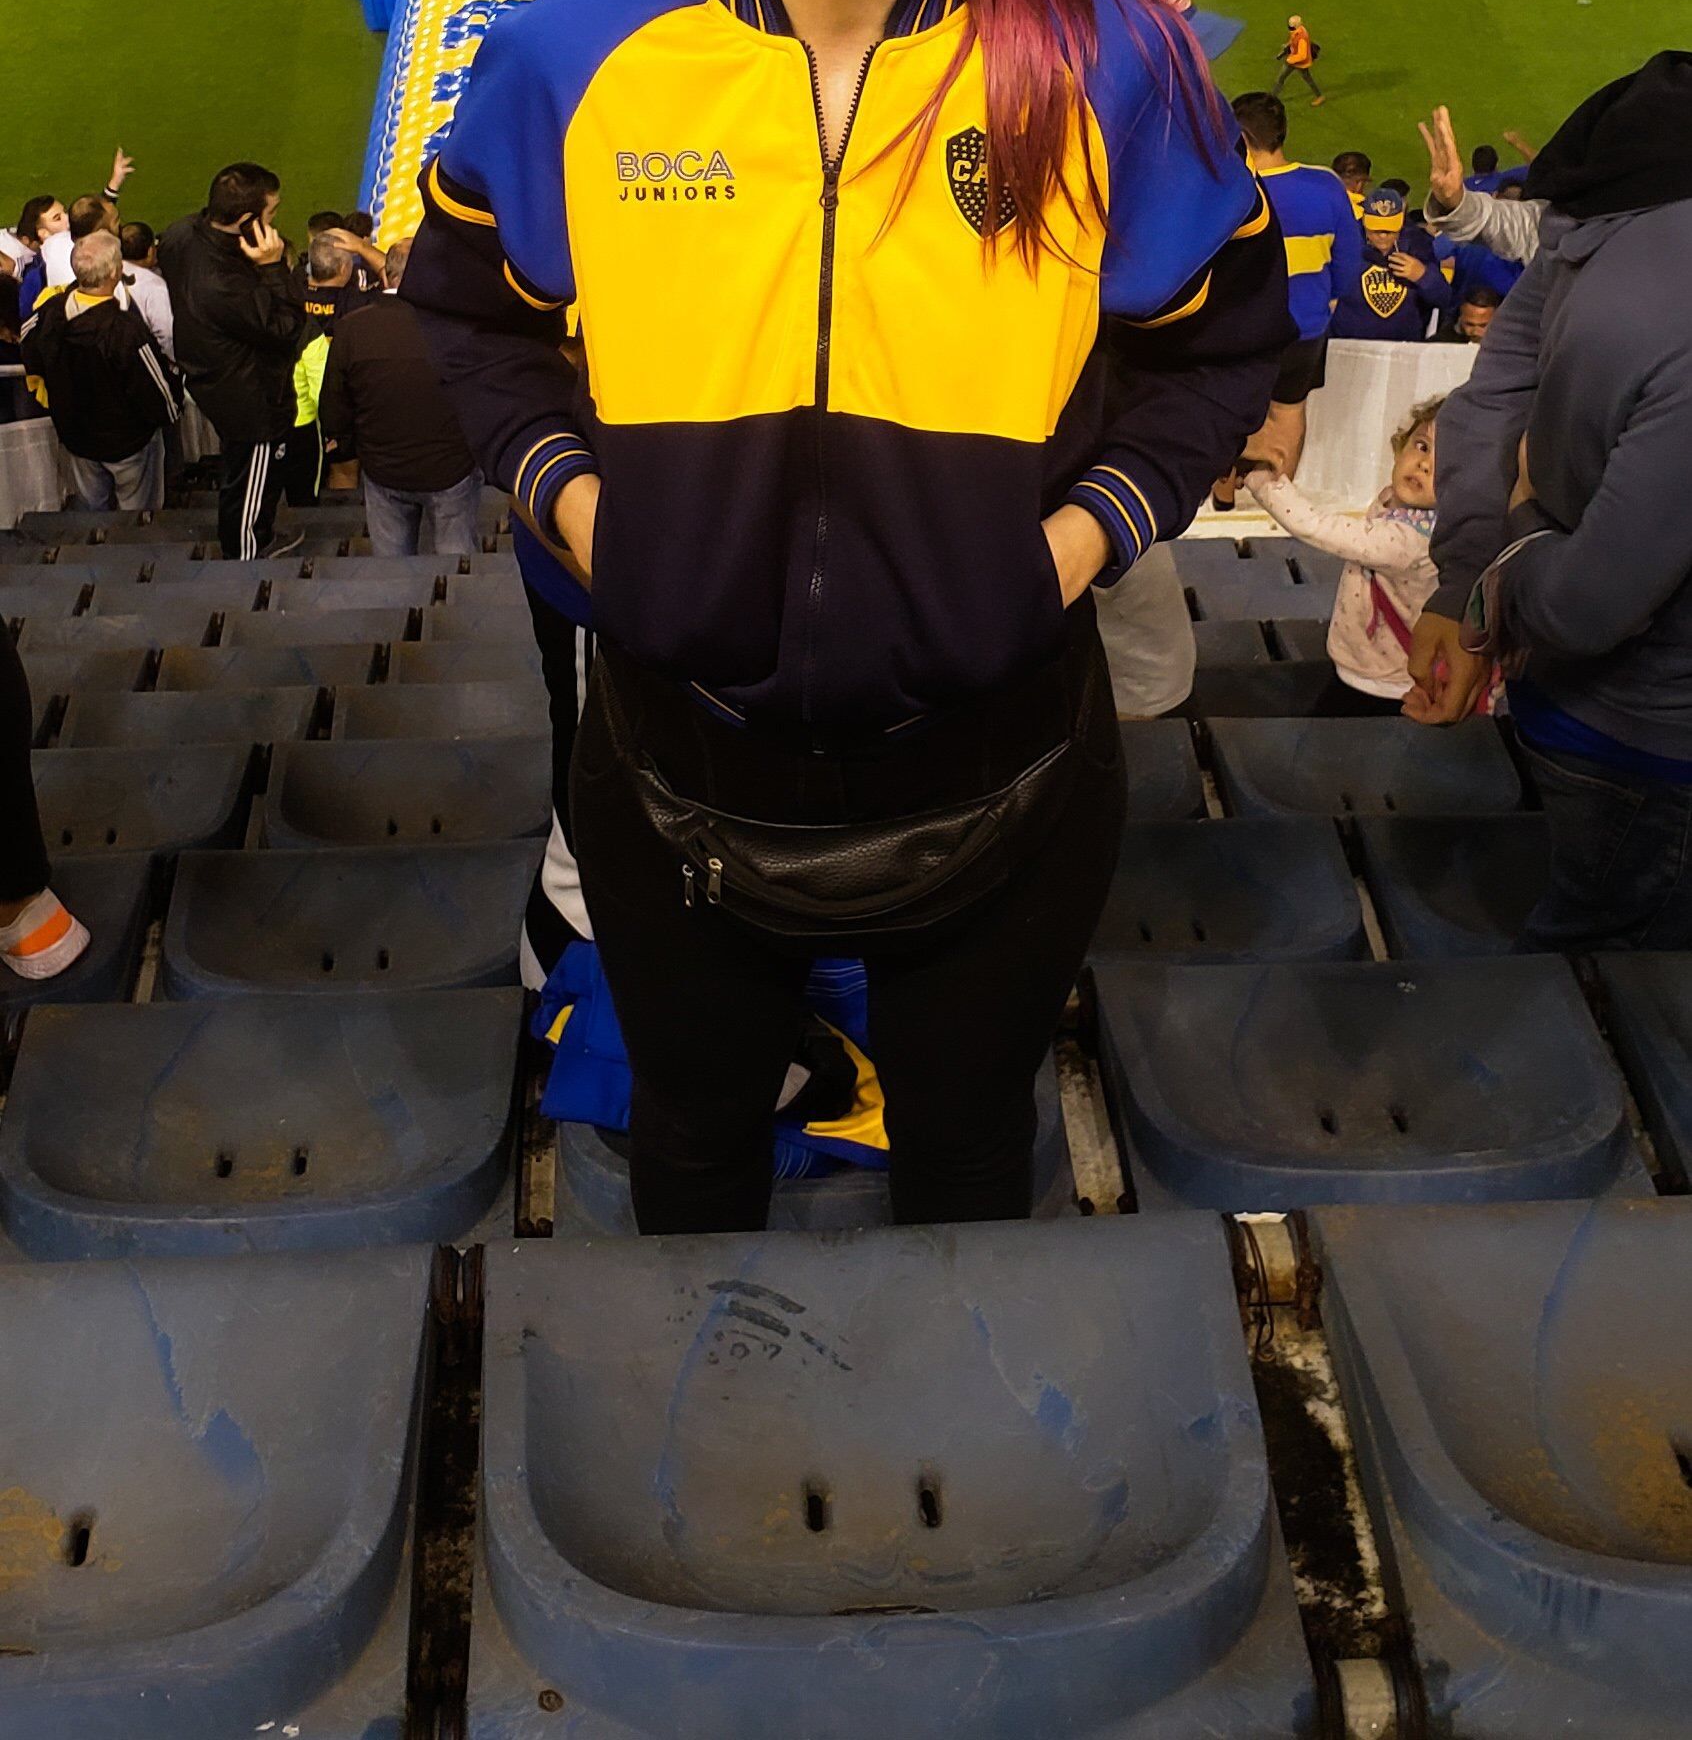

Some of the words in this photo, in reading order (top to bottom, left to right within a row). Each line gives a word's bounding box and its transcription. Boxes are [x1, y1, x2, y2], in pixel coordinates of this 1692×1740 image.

[616, 150, 735, 182] BOCA
[952, 160, 988, 185] CA
[619, 185, 736, 201] JUNIORS
